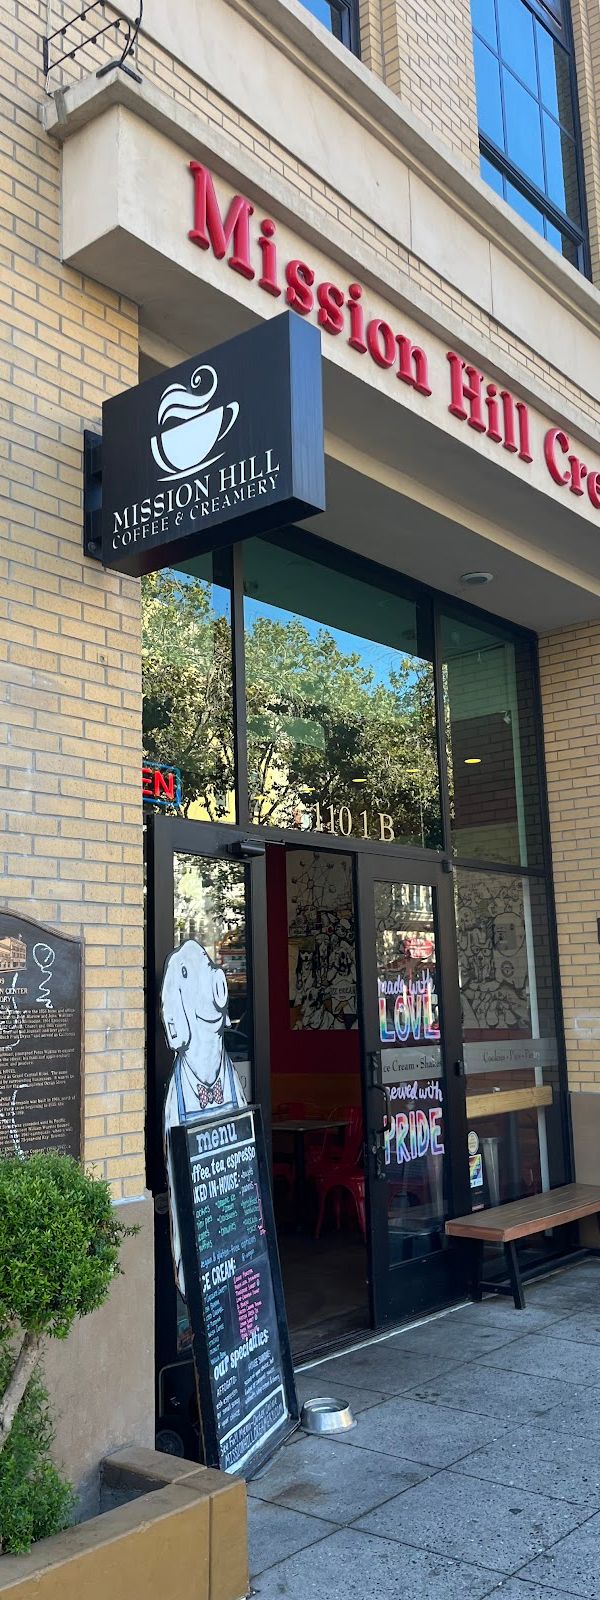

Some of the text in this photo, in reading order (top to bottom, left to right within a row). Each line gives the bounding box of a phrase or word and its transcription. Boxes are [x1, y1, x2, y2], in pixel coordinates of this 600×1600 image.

[188, 160, 432, 397] Mission
[445, 352, 534, 464] Hill
[112, 448, 281, 534] MISSION HILL
[112, 474, 278, 550] COFFEE & CREAMERY
[377, 974, 406, 997] made
[408, 968, 436, 994] with
[378, 994, 440, 1042] LOVE
[392, 1059, 414, 1072] Cream
[419, 1080, 444, 1102] with
[196, 1122, 238, 1153] menu
[383, 1108, 445, 1165] PRIDE
[227, 1146, 256, 1169] espresso
[214, 1355, 229, 1380] our
